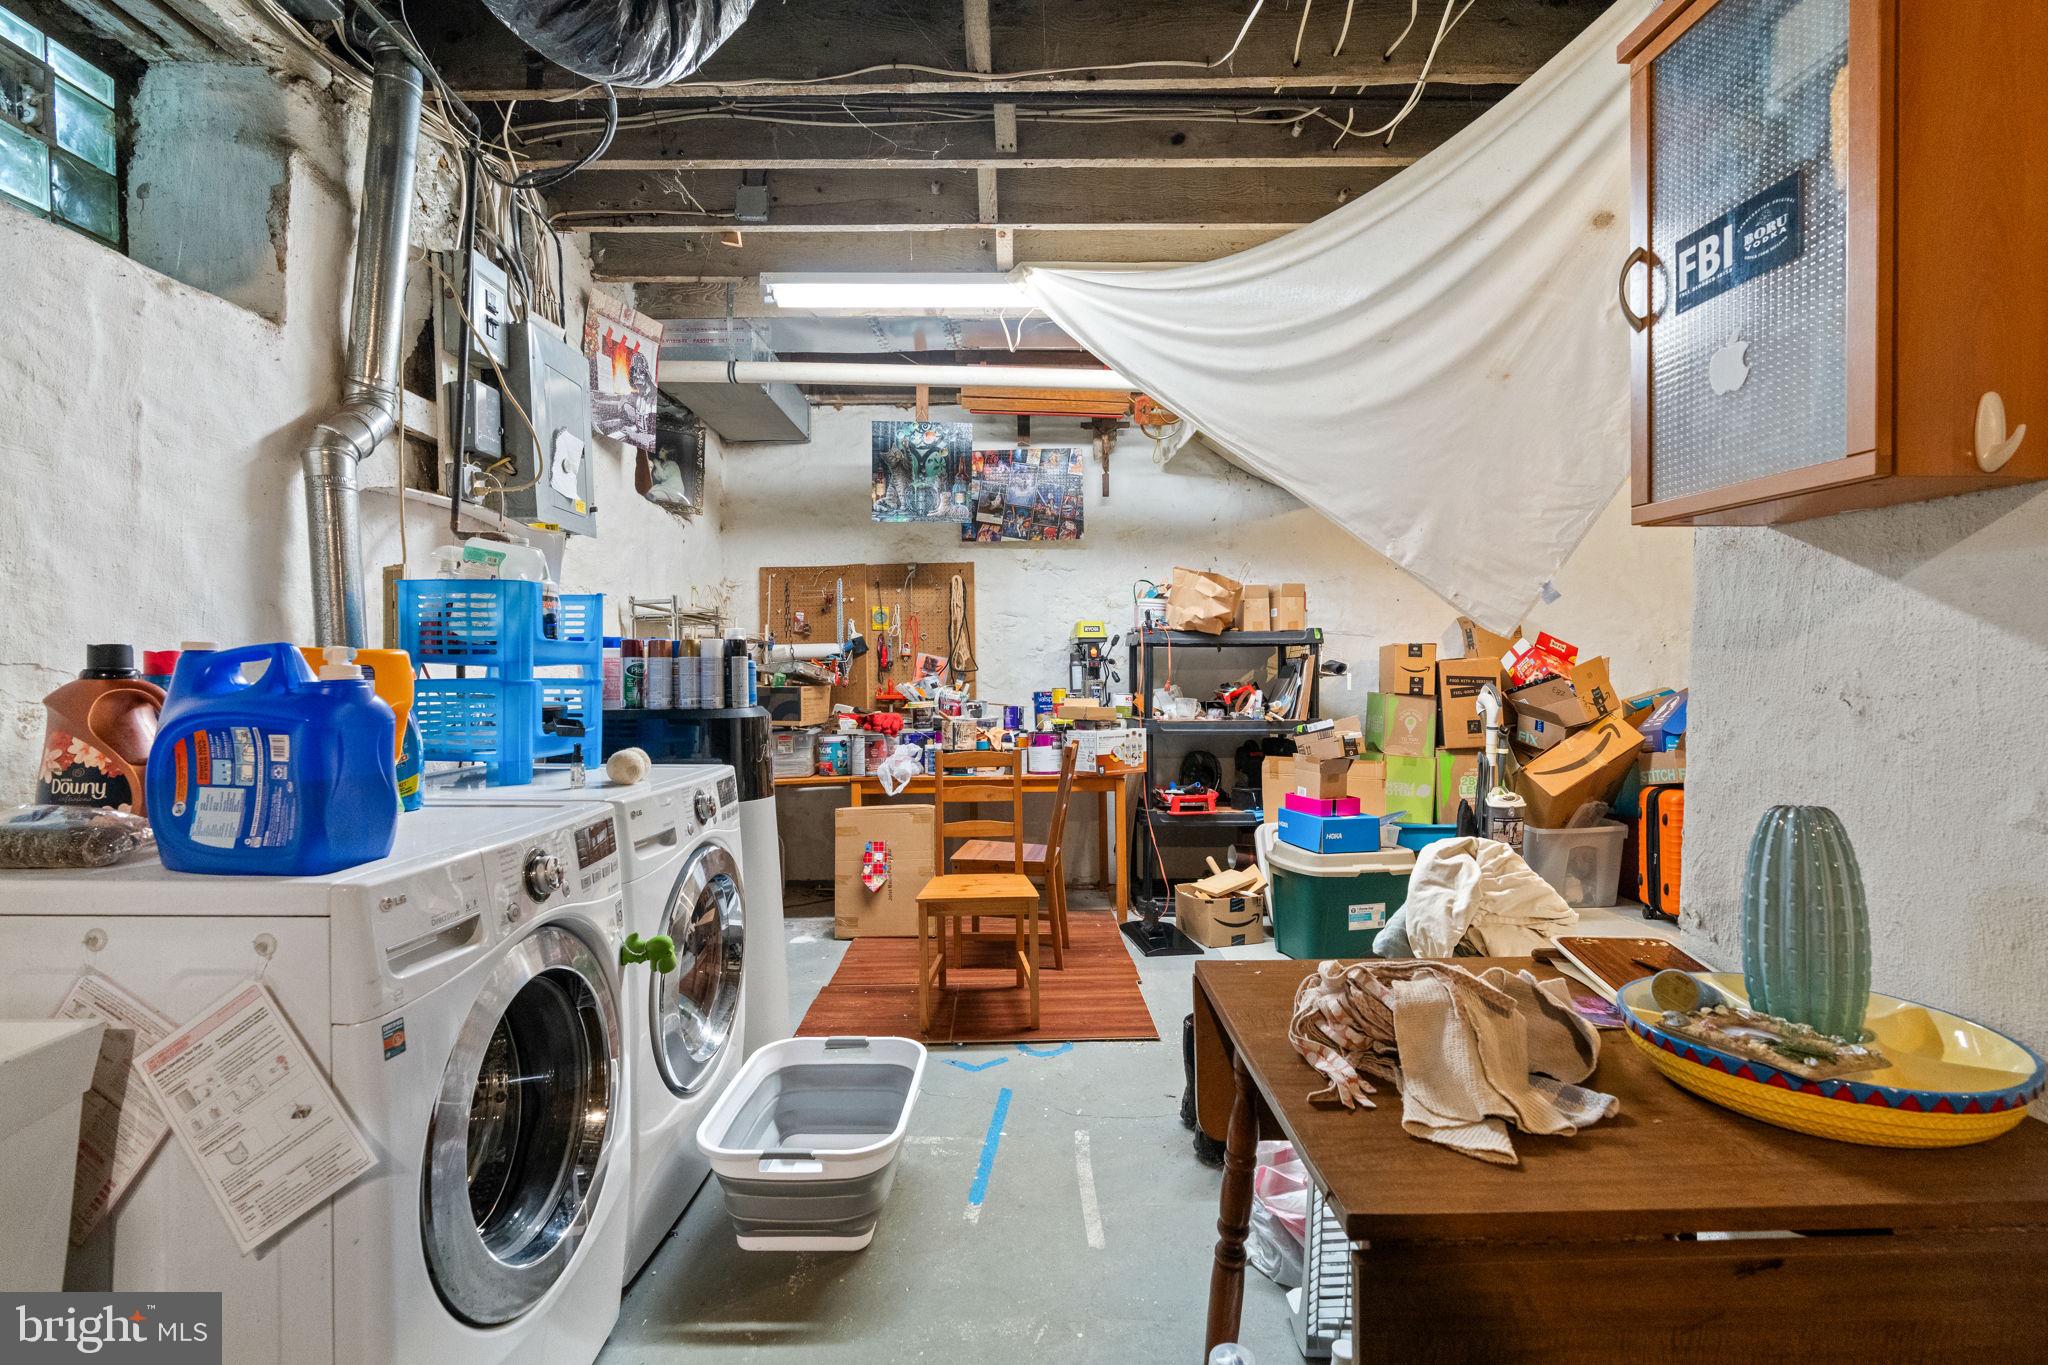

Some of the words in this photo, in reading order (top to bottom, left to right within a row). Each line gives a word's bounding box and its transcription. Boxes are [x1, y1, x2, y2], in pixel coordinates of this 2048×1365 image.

[1743, 213, 1789, 245] BORU
[1744, 226, 1787, 252] VODKA
[1679, 224, 1733, 292] FBI
[1519, 730, 1538, 746] FIX
[1640, 769, 1675, 783] STITCH
[51, 778, 107, 800] Downy
